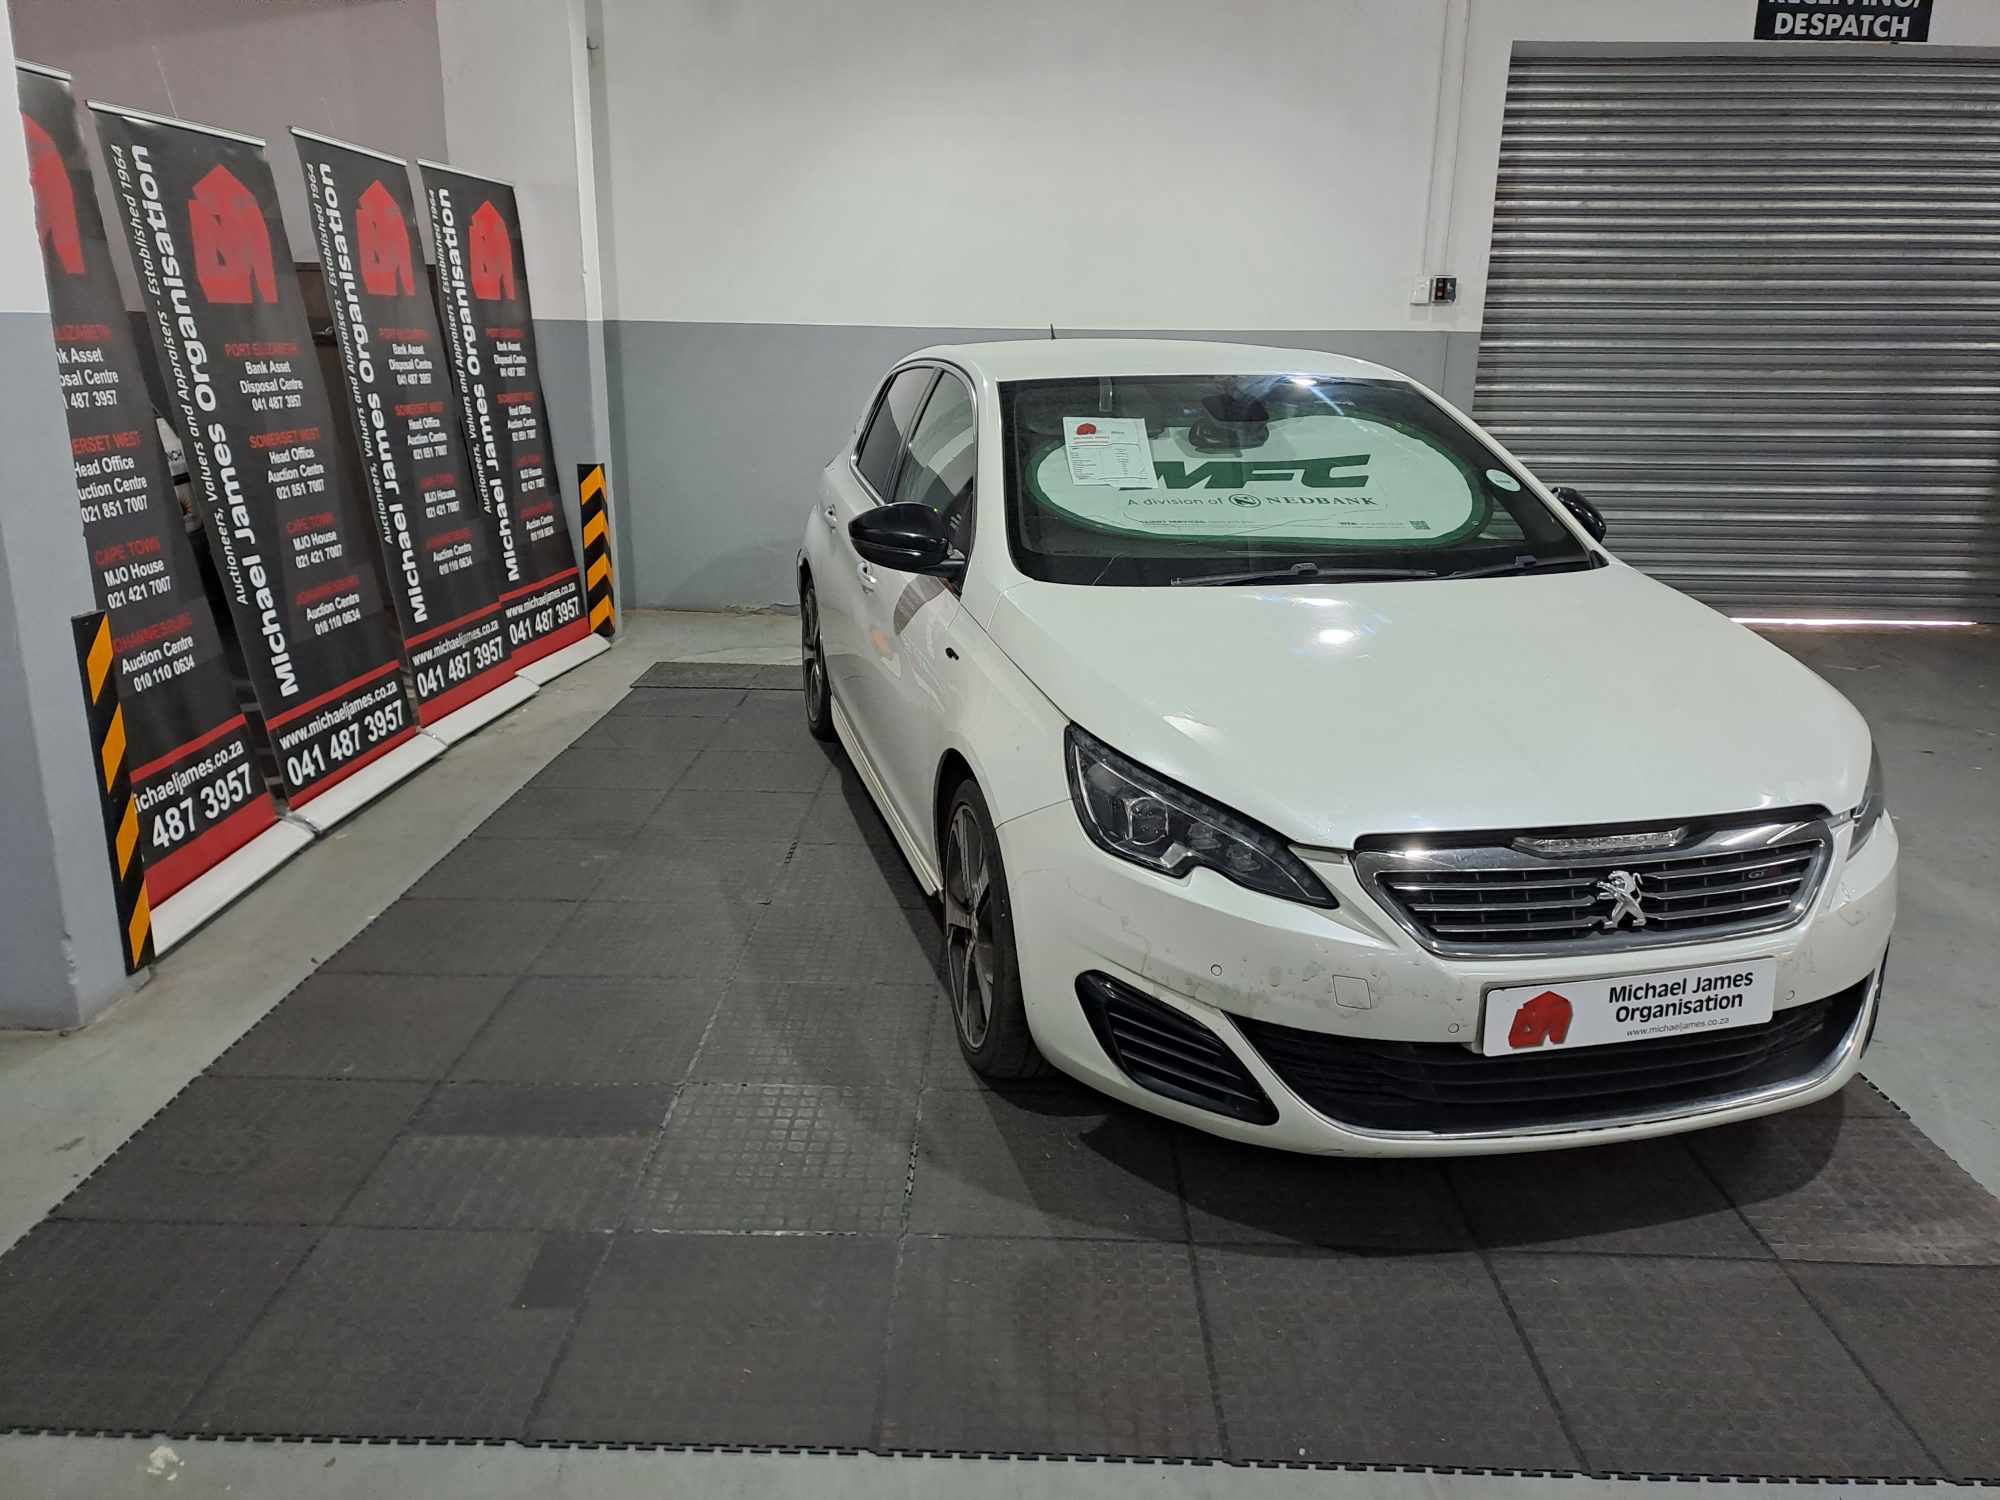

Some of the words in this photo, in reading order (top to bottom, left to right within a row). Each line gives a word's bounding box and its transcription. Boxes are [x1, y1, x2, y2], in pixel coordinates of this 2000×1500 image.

[1774, 13, 1910, 37] DESPATCH
[111, 144, 132, 189] 1964
[122, 193, 160, 296] Established
[314, 203, 337, 287] Established
[132, 145, 216, 412] Organisation
[319, 163, 375, 384] Organisation
[438, 188, 480, 376] Organisation
[335, 299, 356, 374] Appraisers
[71, 347, 103, 363] Asset
[158, 311, 189, 402] Appraisers
[245, 360, 268, 375] Bank
[270, 360, 291, 373] Asset
[84, 369, 119, 385] Centre
[240, 378, 279, 395] Disposal
[279, 377, 304, 390] Centre
[350, 376, 362, 404] and
[457, 369, 469, 393] and
[70, 392, 90, 409] 487
[92, 389, 118, 407] 3957
[252, 397, 268, 411] 041
[269, 396, 283, 409] 487
[181, 404, 199, 437] and
[357, 406, 374, 457] Valuers
[463, 396, 477, 439] Valuers
[474, 384, 499, 471] James
[268, 448, 291, 464] Head
[290, 446, 315, 461] Office
[368, 393, 400, 494] James
[102, 455, 135, 473] Office
[194, 441, 218, 501] Valuers
[268, 467, 300, 483] Auction
[300, 463, 325, 477] Centre
[114, 475, 148, 493] Centre
[208, 423, 255, 544] James
[275, 485, 292, 500] 021
[291, 482, 307, 497] 851
[81, 504, 101, 523] 021
[102, 500, 123, 518] 851
[124, 494, 148, 513] 7007
[370, 463, 393, 544] Auctioneers,
[1143, 496, 1199, 506] division
[1208, 496, 1223, 505] of
[1266, 496, 1377, 506] NEDBANK
[292, 535, 311, 551] MJO
[310, 530, 337, 546] House
[489, 478, 520, 582] Michael
[104, 566, 129, 588] MJO
[130, 559, 165, 579] House
[214, 508, 248, 605] Auctioneers,
[310, 549, 325, 564] 421
[388, 503, 428, 624] Michael
[107, 591, 127, 610] 021
[128, 582, 148, 602] 421
[150, 576, 171, 596] 7007
[242, 554, 299, 698] Michael
[306, 602, 336, 622] Auction
[509, 617, 533, 644] 041
[535, 608, 553, 632] 487
[555, 596, 580, 624] 3957
[122, 648, 162, 675] Auction
[163, 635, 194, 658] Centre
[416, 664, 445, 697] 041
[448, 651, 472, 681] 487
[474, 636, 503, 669] 3957
[133, 672, 151, 693] 010
[152, 663, 172, 684] 110
[279, 681, 398, 750] www.michaeljames.co.za
[287, 743, 326, 786] 041
[330, 722, 360, 761] 487
[364, 700, 403, 742] 3957
[152, 797, 195, 848] 487
[200, 762, 252, 819] 3957
[1609, 977, 1687, 1003] Michael
[1692, 971, 1753, 993] James
[1615, 993, 1743, 1022] Organisation
[1626, 1017, 1729, 1037] www.michaeljames.co.za
